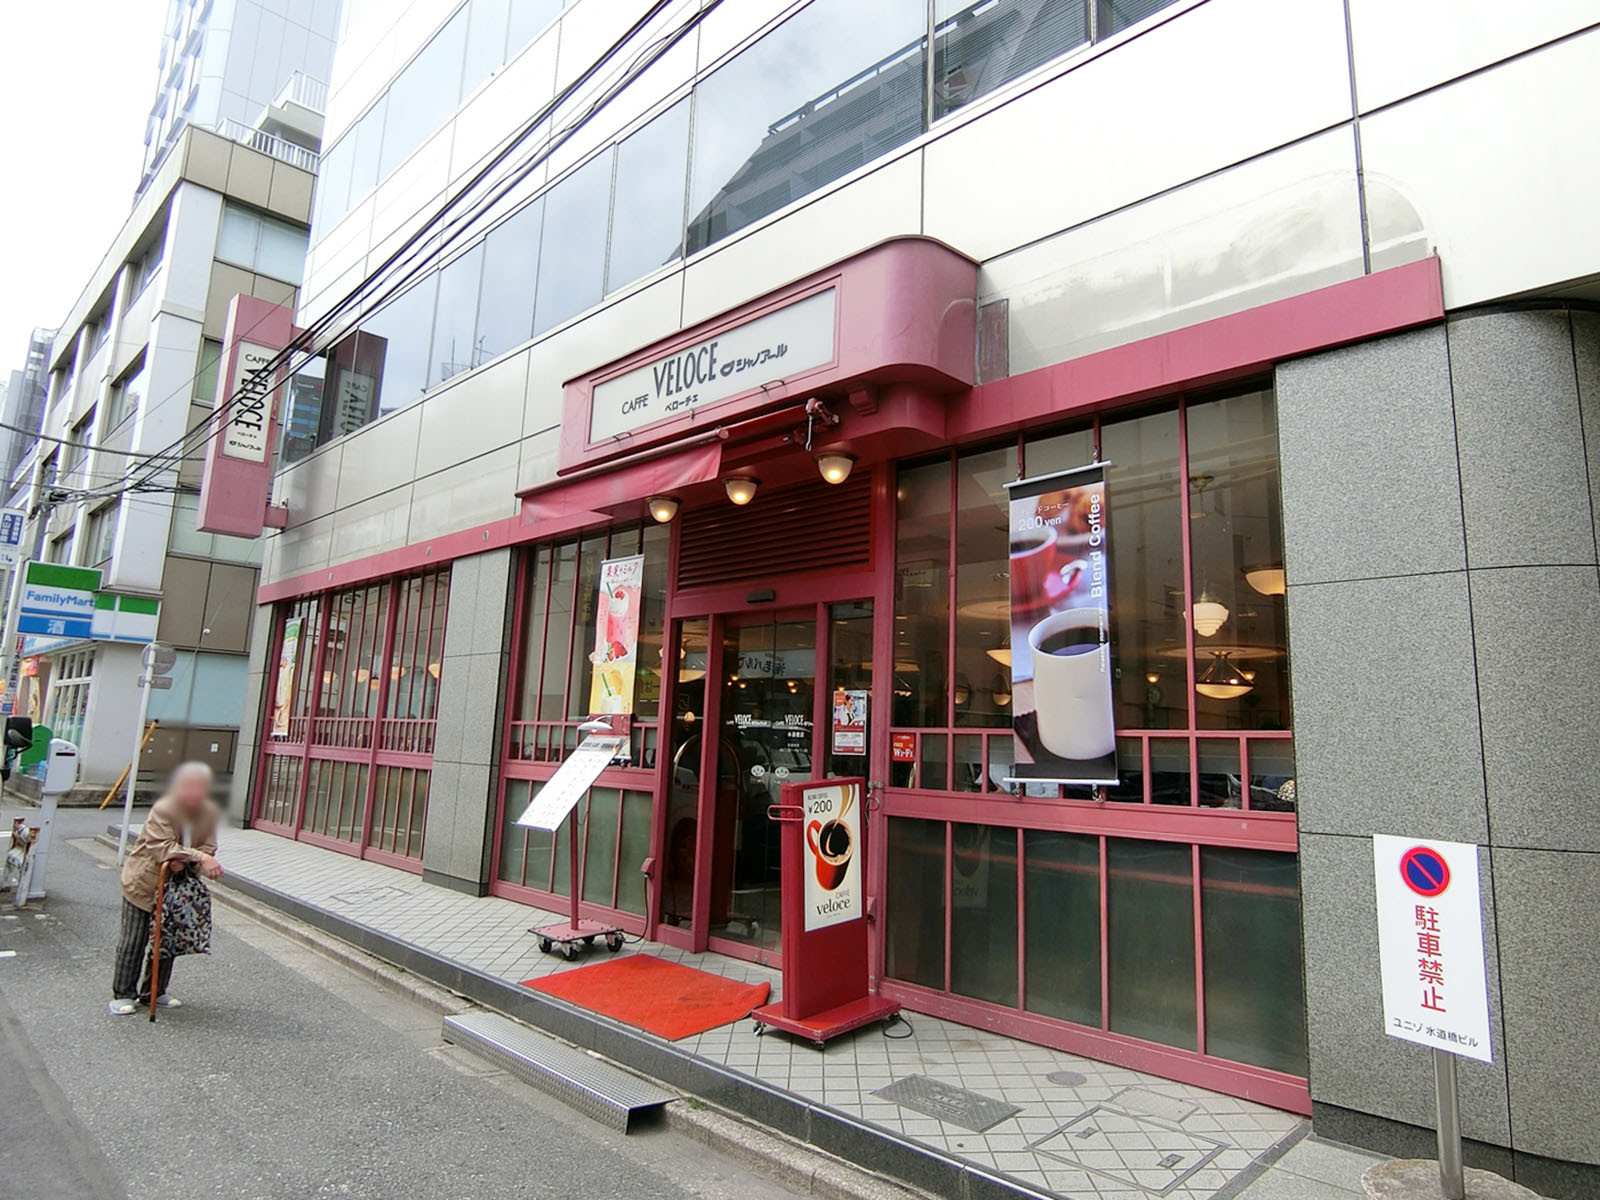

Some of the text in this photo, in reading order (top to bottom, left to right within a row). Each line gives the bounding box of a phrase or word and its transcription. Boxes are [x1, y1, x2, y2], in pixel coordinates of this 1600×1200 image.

[245, 353, 269, 365] CAFF
[736, 343, 788, 373] シャノアール
[621, 341, 718, 415] CAFFE VELOCE
[1018, 515, 1062, 531] 200 yen
[1088, 493, 1102, 547] Coffee
[1090, 551, 1102, 598] Blend
[26, 590, 94, 607] FamilyMart
[893, 748, 913, 758] Wi-Fi
[816, 898, 852, 916] veloce
[1414, 904, 1447, 1013] 駐車禁止
